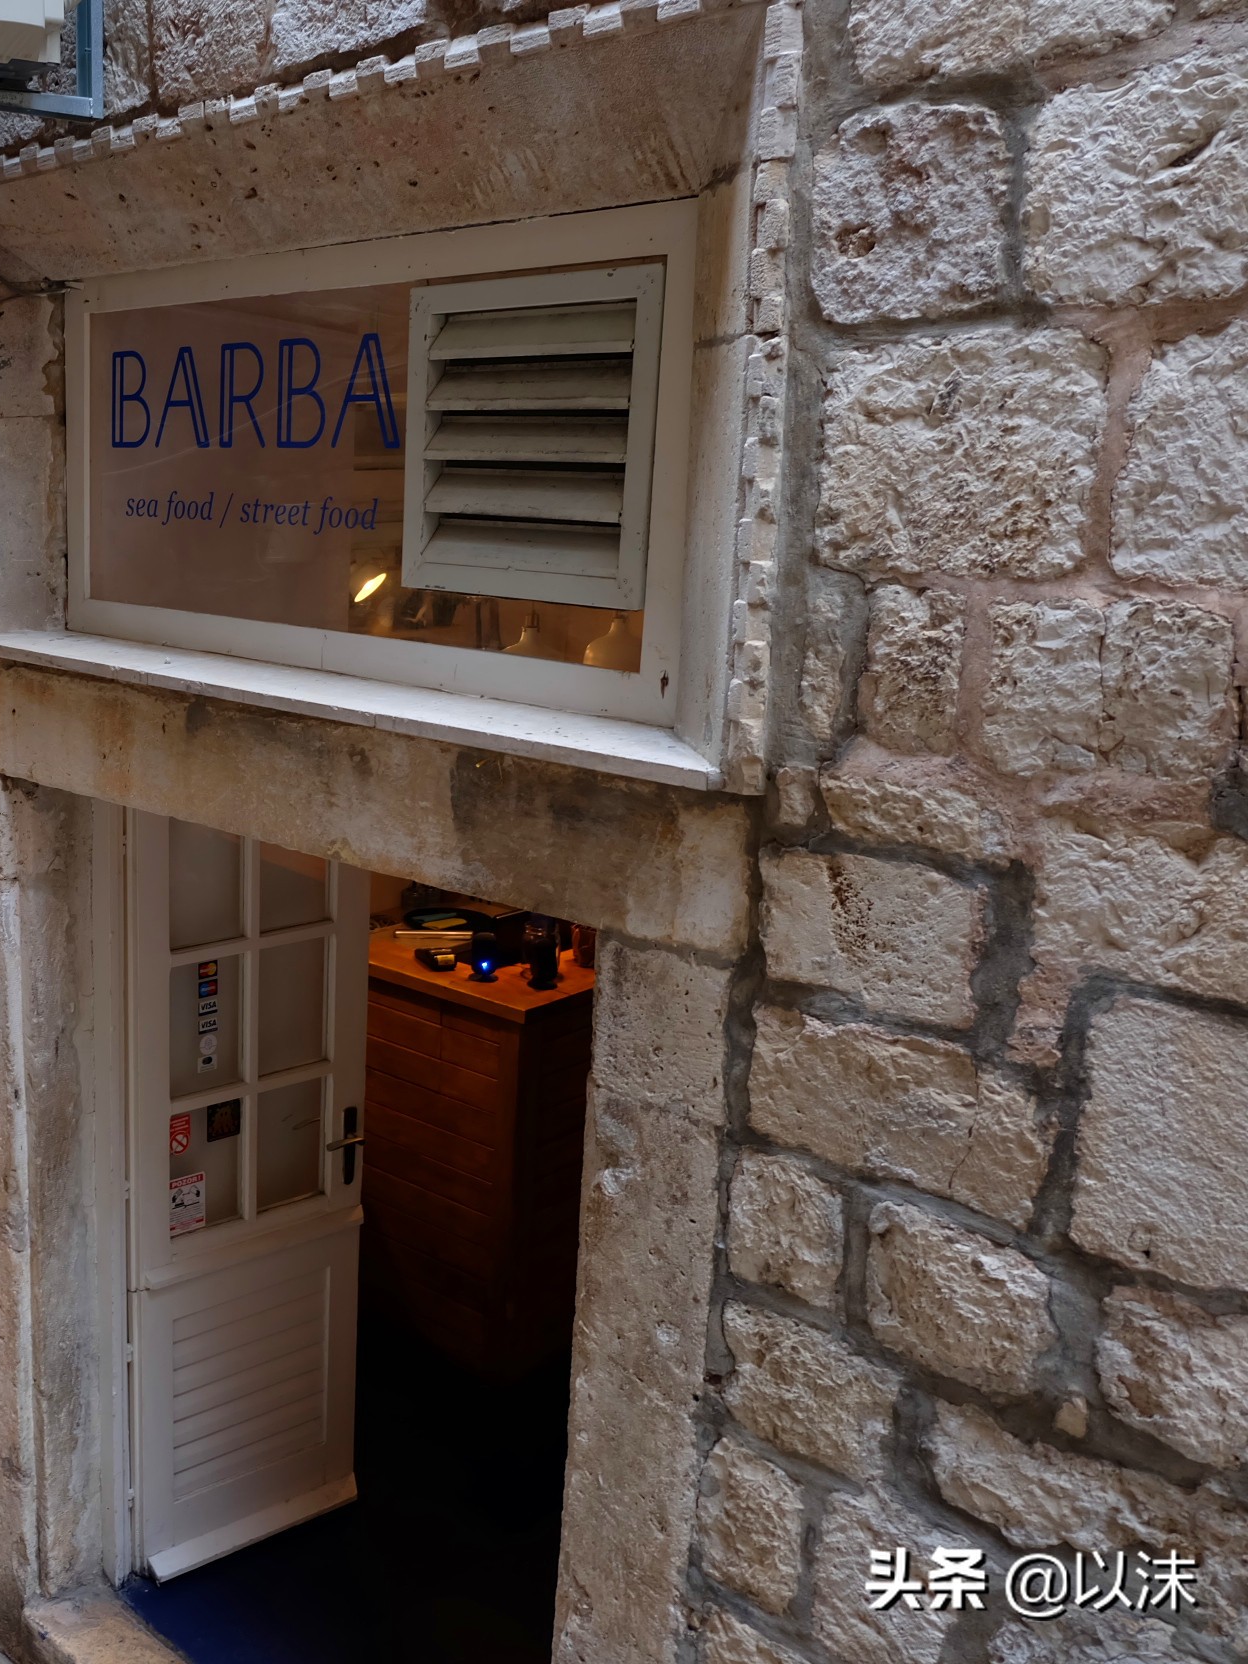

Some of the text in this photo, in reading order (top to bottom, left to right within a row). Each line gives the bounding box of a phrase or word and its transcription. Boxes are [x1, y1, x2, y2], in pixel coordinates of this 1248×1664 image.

[112, 333, 400, 448] BARBA
[125, 497, 158, 517] sea
[162, 491, 215, 526] food
[240, 498, 311, 526] street
[313, 496, 379, 535] food
[200, 1000, 217, 1011] VISA
[200, 1019, 217, 1029] VISA
[171, 1174, 202, 1189] POZOR!
